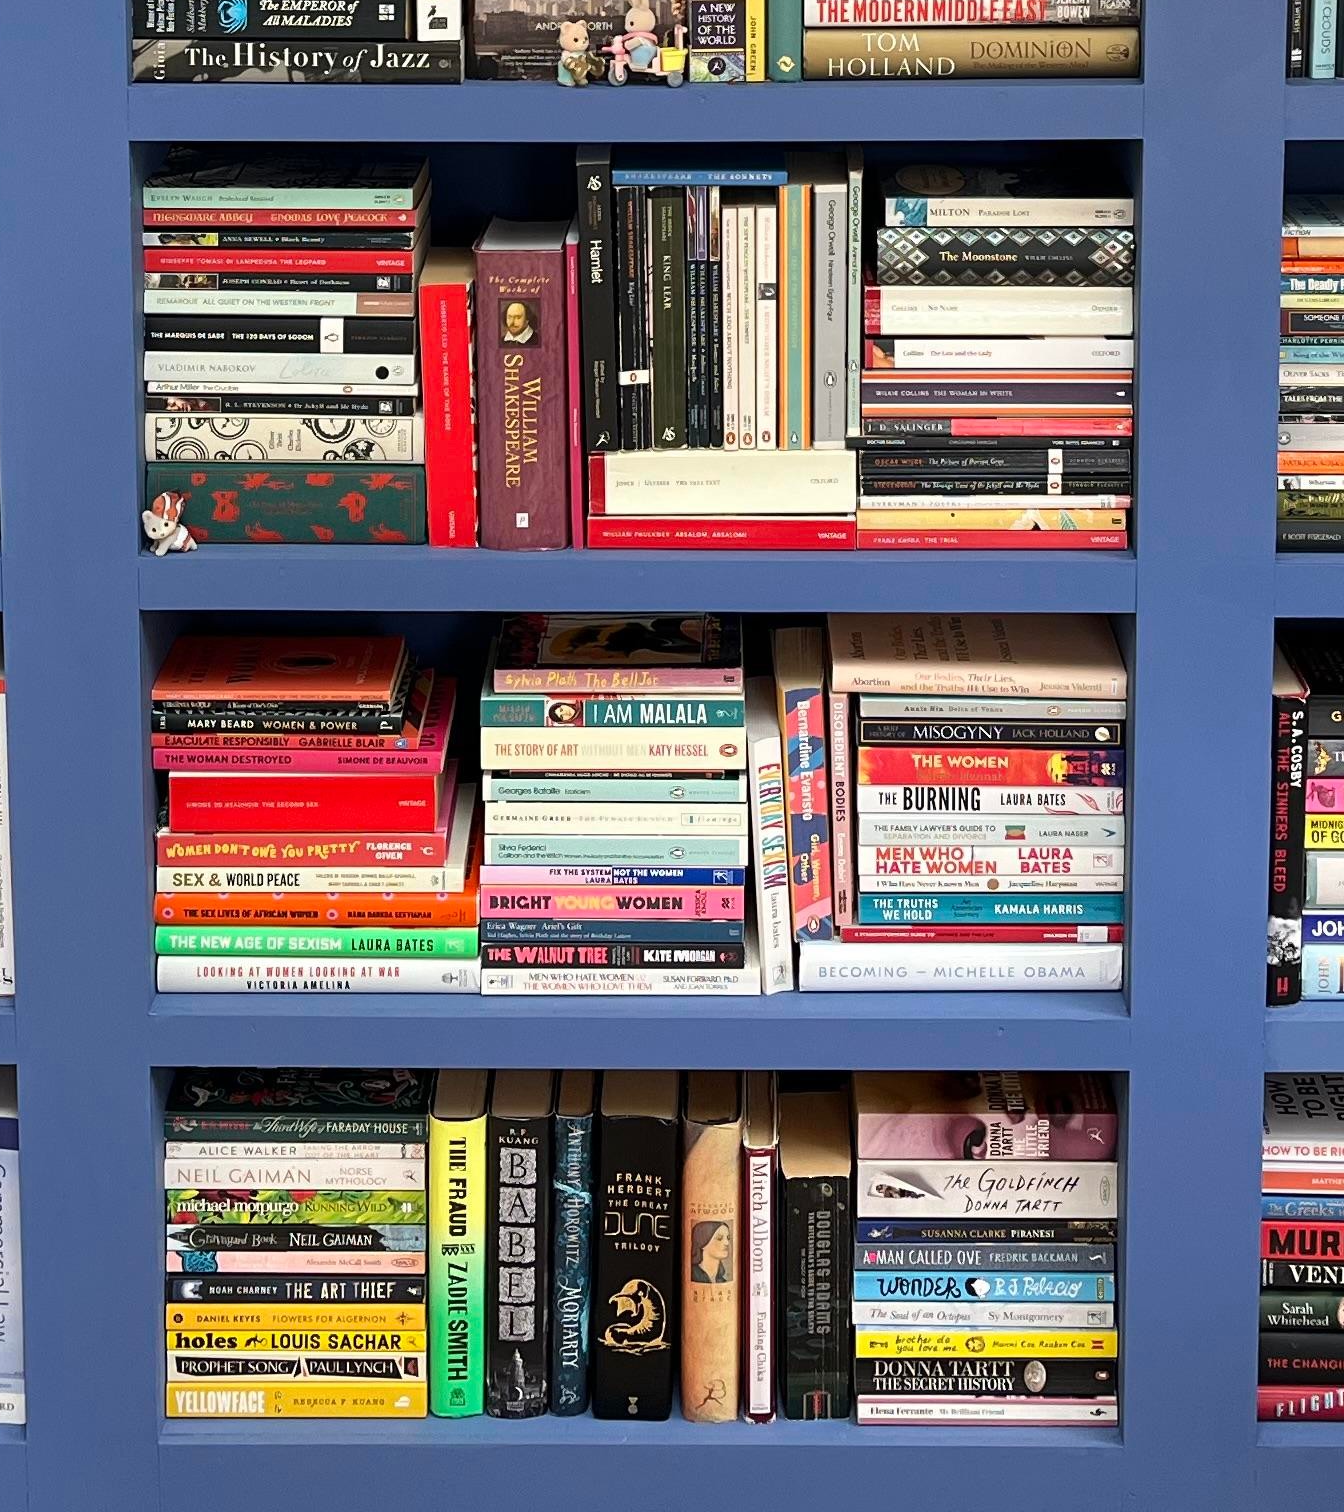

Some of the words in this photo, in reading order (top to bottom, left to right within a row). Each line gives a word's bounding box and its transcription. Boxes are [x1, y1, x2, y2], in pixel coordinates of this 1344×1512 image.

[929, 207, 970, 217] MILTON
[939, 251, 959, 262] The
[962, 251, 1017, 263] Moonstone
[158, 364, 205, 372] VLADIMIR
[208, 364, 256, 373] NABOKOV
[504, 354, 523, 488] SHAKESPEARE
[522, 377, 541, 464] WILLIAM
[913, 724, 1004, 741] MISOGYNY
[1012, 728, 1039, 739] JACK
[1042, 728, 1089, 739] HOLLAND
[878, 791, 897, 806] THE
[903, 787, 981, 812] BURNING
[173, 873, 205, 887] SEX
[209, 873, 221, 887] &
[226, 872, 265, 886] WORLD
[267, 873, 300, 886] PEACE
[351, 939, 391, 952] LAURA
[396, 939, 433, 951] BATES
[818, 965, 908, 978] BECOMING
[933, 966, 1016, 978] MICHELLE
[1024, 966, 1086, 978] OBAMA
[449, 1137, 467, 1172] THE
[177, 1169, 222, 1184] NEIL
[228, 1168, 311, 1183] GAIMAN
[449, 1179, 468, 1237] FRAUD
[447, 1262, 468, 1316] ZADIE
[175, 1333, 237, 1349] holes
[271, 1335, 320, 1349] LOUIS
[328, 1335, 401, 1349] SACHAR
[449, 1319, 468, 1381] SMITH
[873, 1361, 945, 1377] DONNA
[950, 1360, 1015, 1377] TARTT
[873, 1377, 901, 1391] THE
[904, 1377, 954, 1391] SECRET
[957, 1377, 1015, 1392] HISTORY
